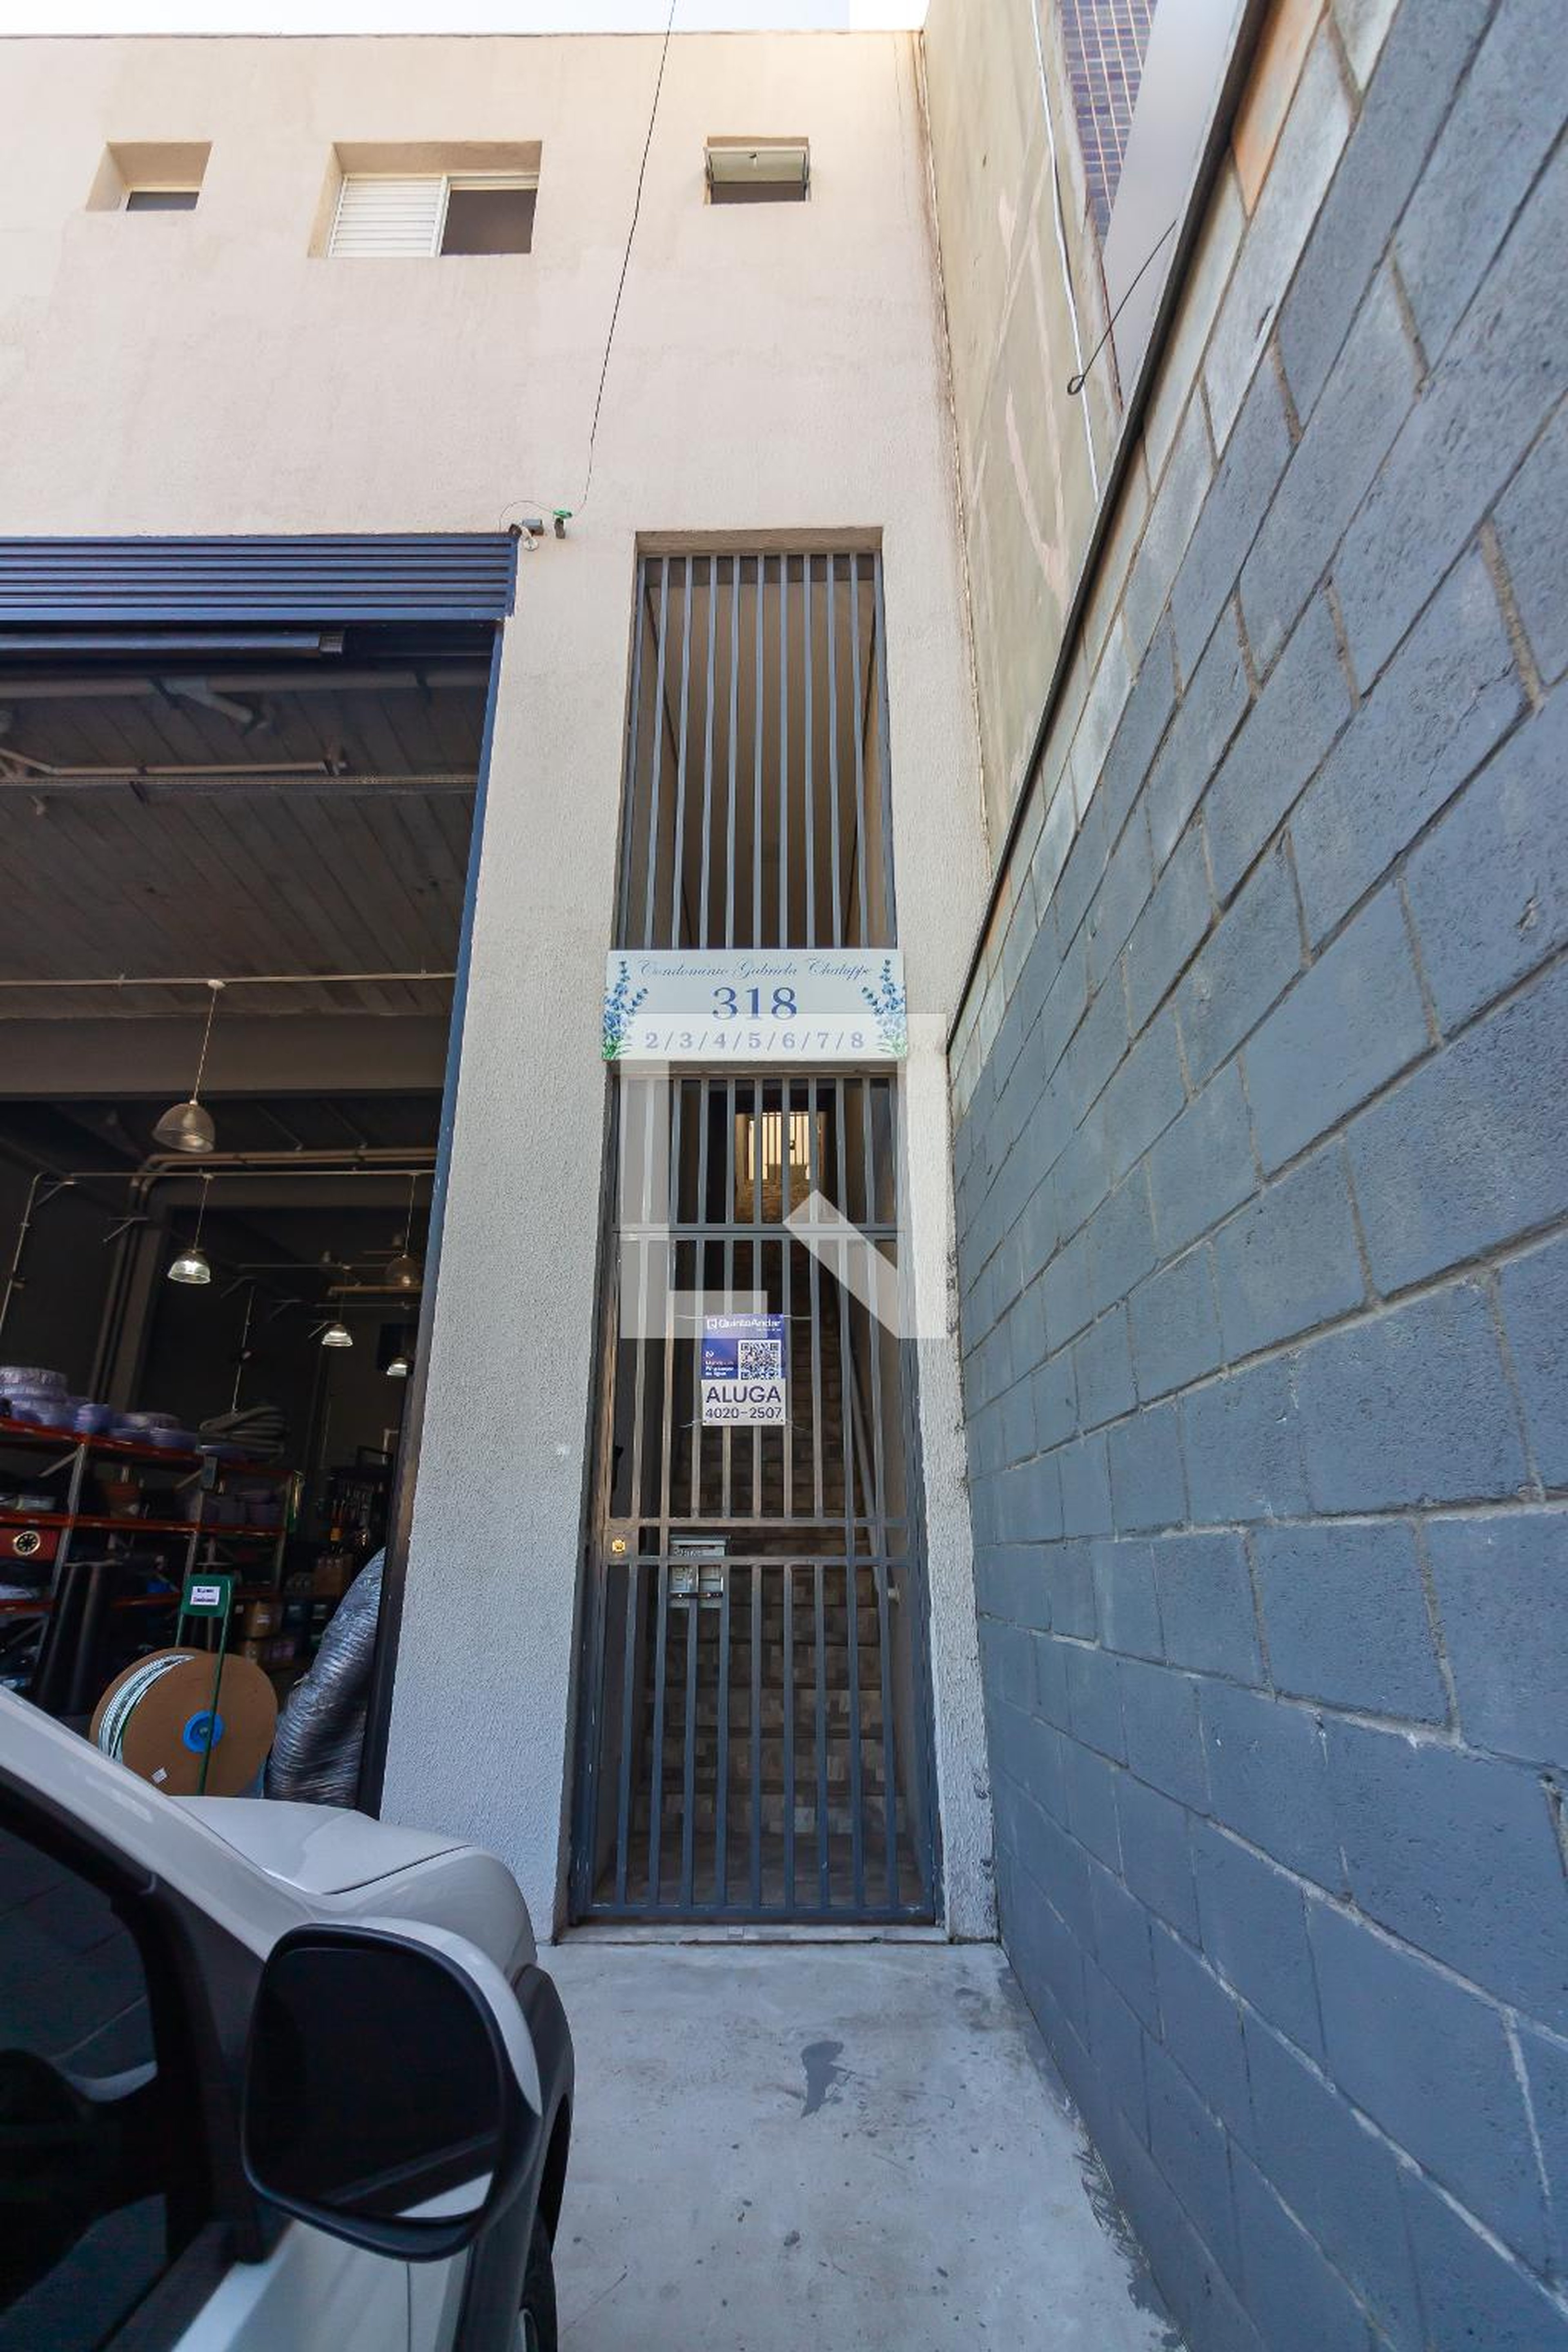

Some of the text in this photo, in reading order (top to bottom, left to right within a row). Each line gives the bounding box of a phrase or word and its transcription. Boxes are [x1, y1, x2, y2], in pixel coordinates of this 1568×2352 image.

[712, 987, 797, 1020] 318
[706, 1386, 782, 1403] ALUGA
[706, 1407, 782, 1419] 4020-2507
